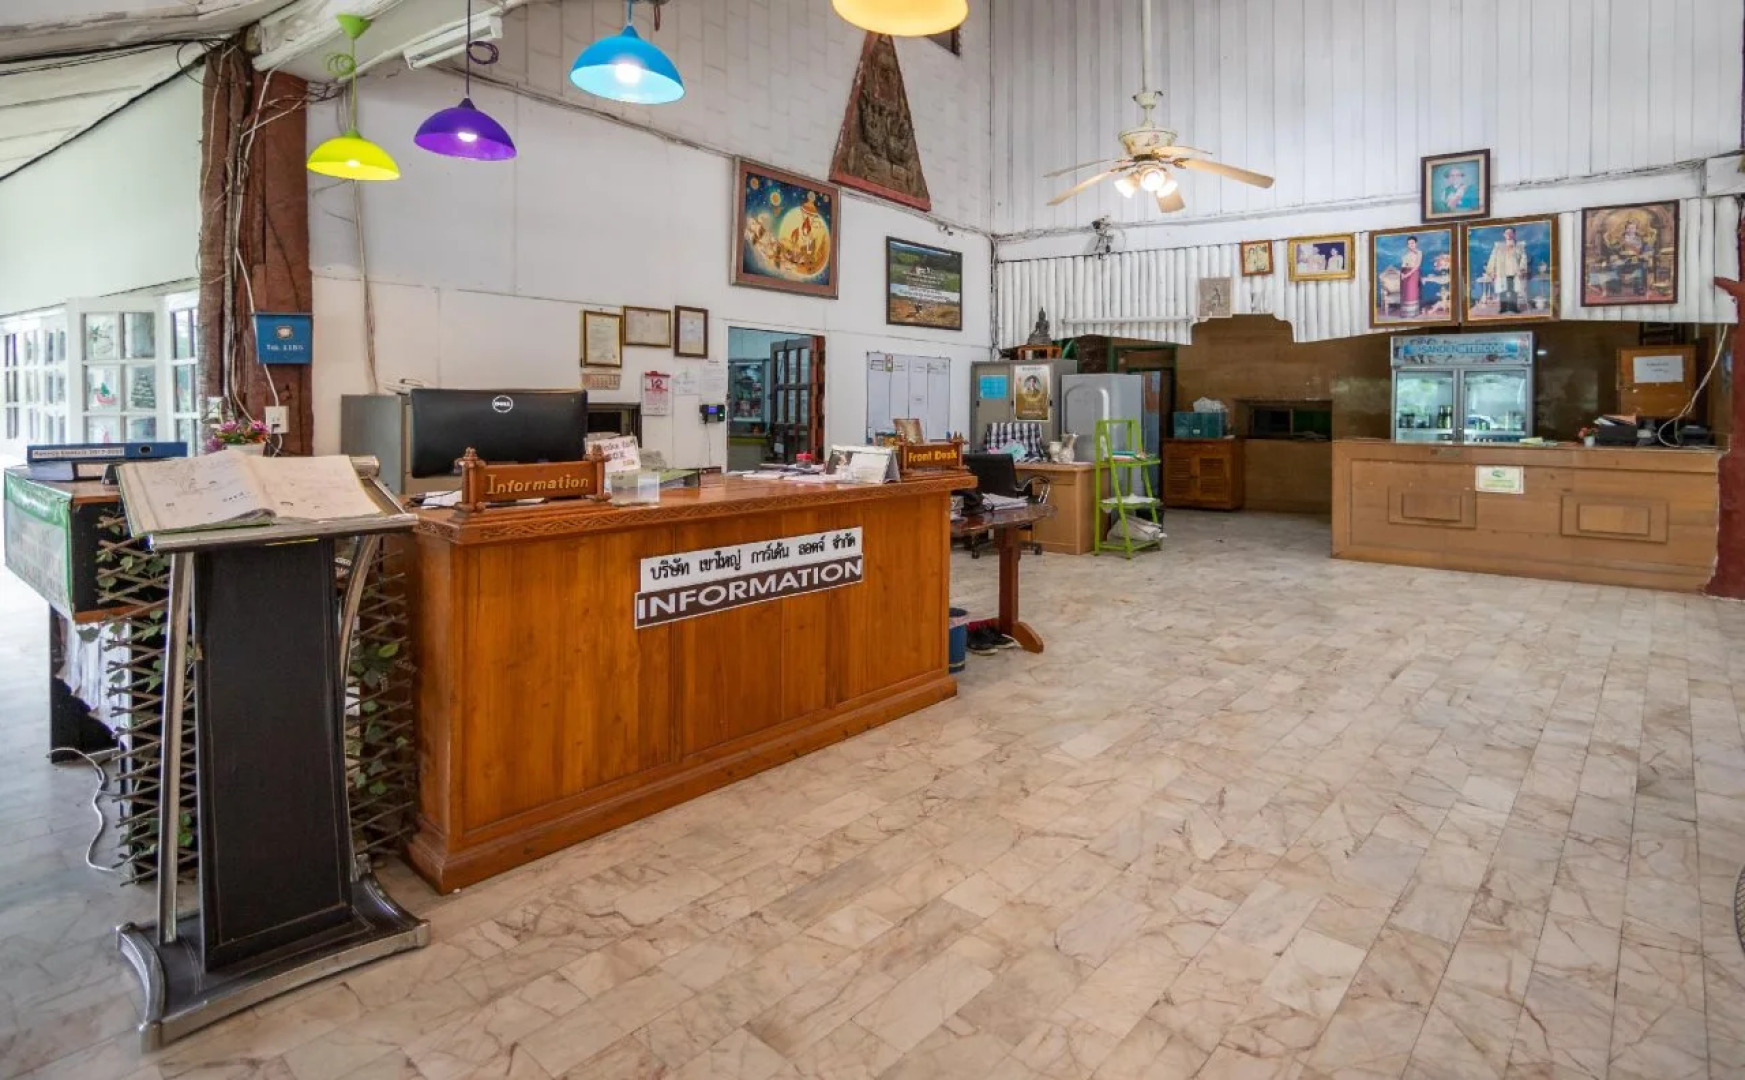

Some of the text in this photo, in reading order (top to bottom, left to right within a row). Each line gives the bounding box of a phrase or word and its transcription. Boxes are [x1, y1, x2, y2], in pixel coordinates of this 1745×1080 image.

[908, 449, 957, 462] Front Desk
[485, 473, 589, 495] Information
[650, 531, 856, 580] บริษัท เขาใหญ่ การ์เด้น ลอดจ์ จำกัด
[638, 557, 862, 620] INFORMATION
